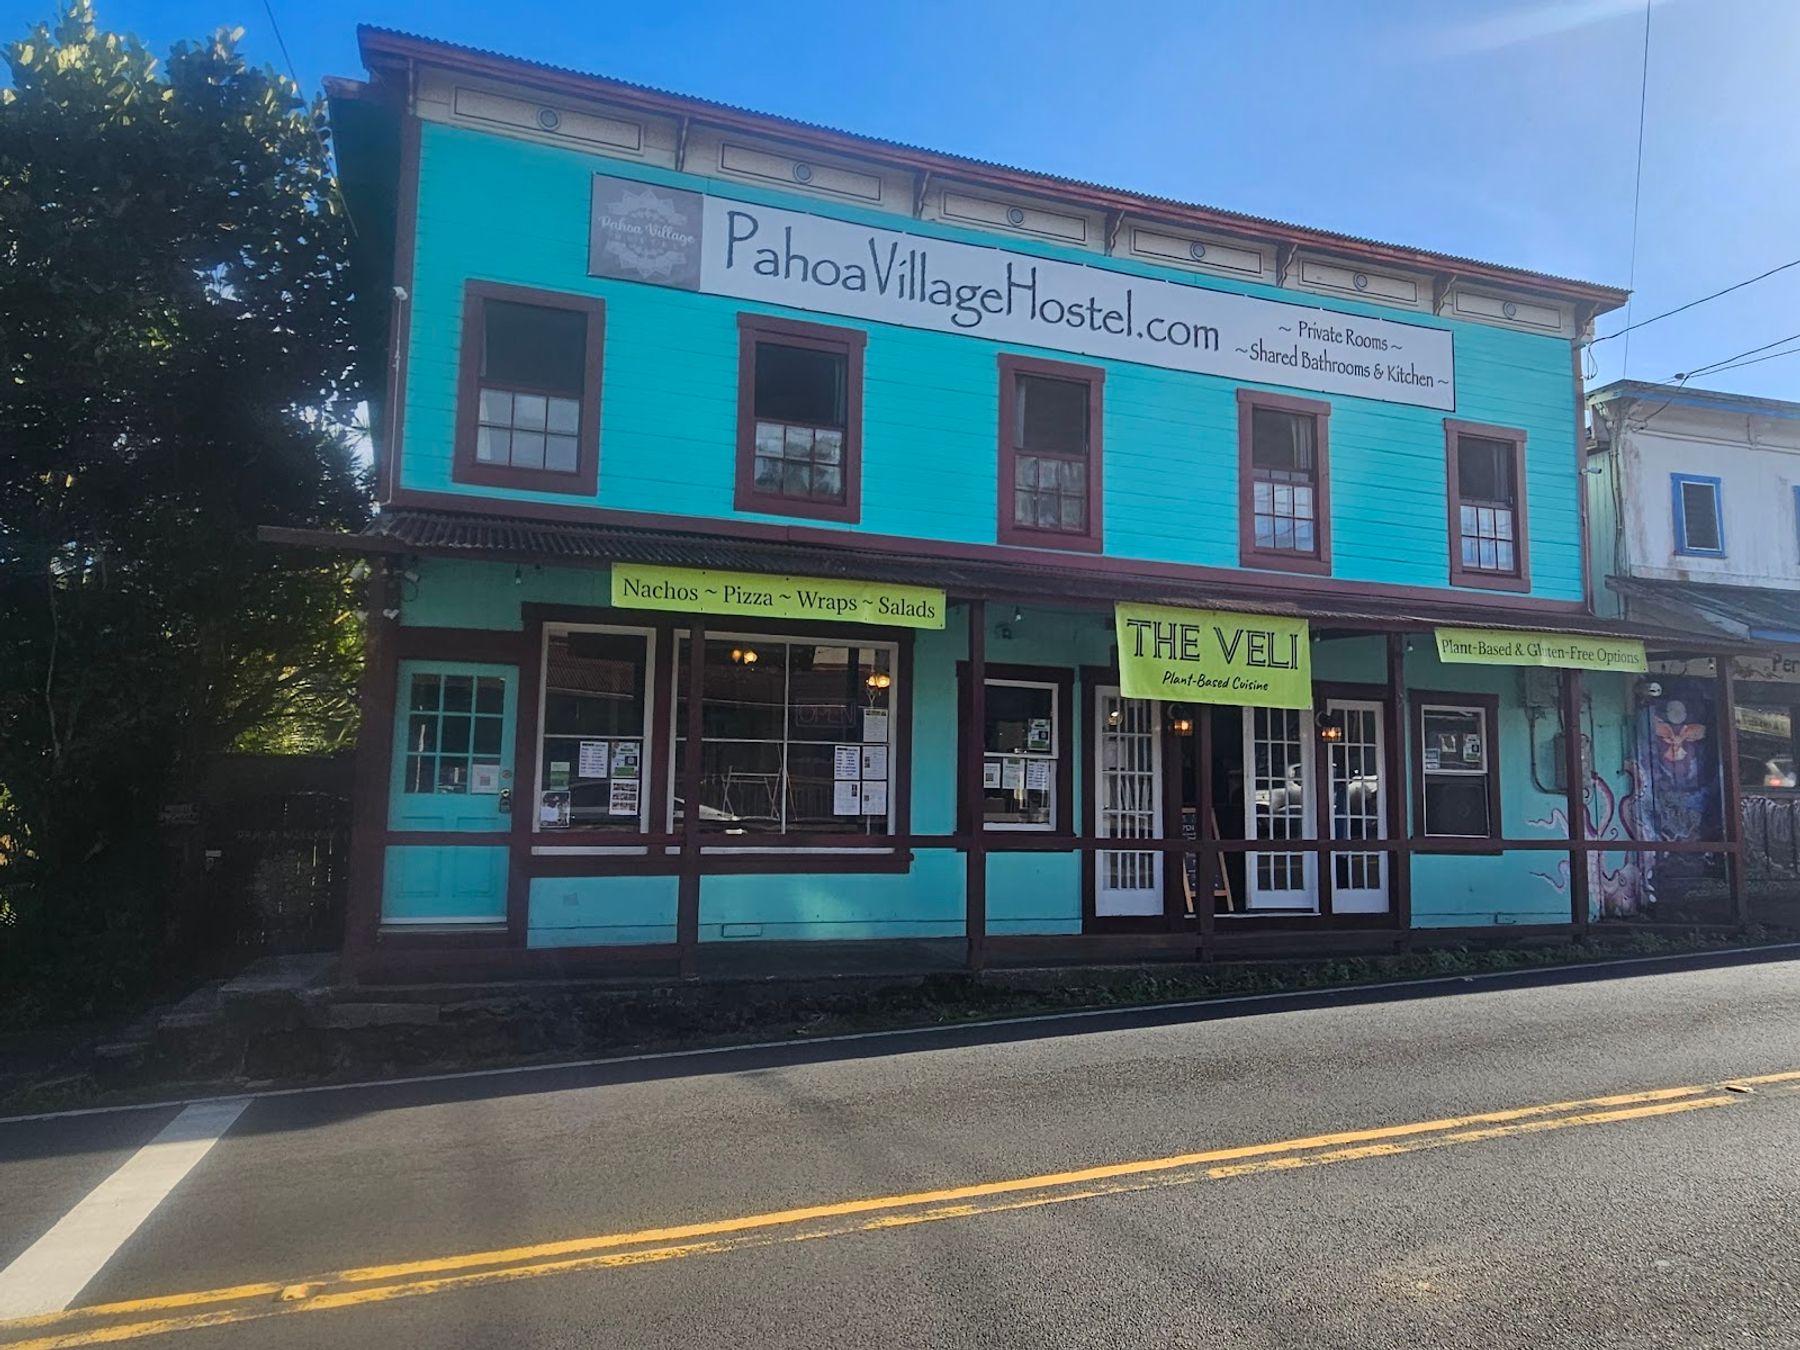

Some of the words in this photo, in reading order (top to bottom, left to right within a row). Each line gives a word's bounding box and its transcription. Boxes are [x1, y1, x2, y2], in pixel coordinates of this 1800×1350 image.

[598, 215, 643, 234] Pahoa
[645, 223, 695, 247] Village
[726, 210, 1219, 352] PahoaVillageHostel.com
[1297, 320, 1342, 344] Private
[1345, 330, 1389, 352] Rooms
[1302, 349, 1371, 378] Bathrooms
[1373, 363, 1384, 380] &
[1387, 362, 1434, 388] Kitchen
[623, 577, 699, 601] Nachos
[723, 584, 774, 607] Pizza
[797, 590, 858, 615] Wraps
[877, 596, 936, 619] Salads
[1126, 618, 1200, 662] THE
[1213, 626, 1299, 670] VELI
[1441, 639, 1512, 657] Plant-Based
[1514, 642, 1524, 656] &
[1597, 647, 1640, 665] Options
[1161, 671, 1229, 689] Plant-Based
[1232, 676, 1269, 692] Cuisine
